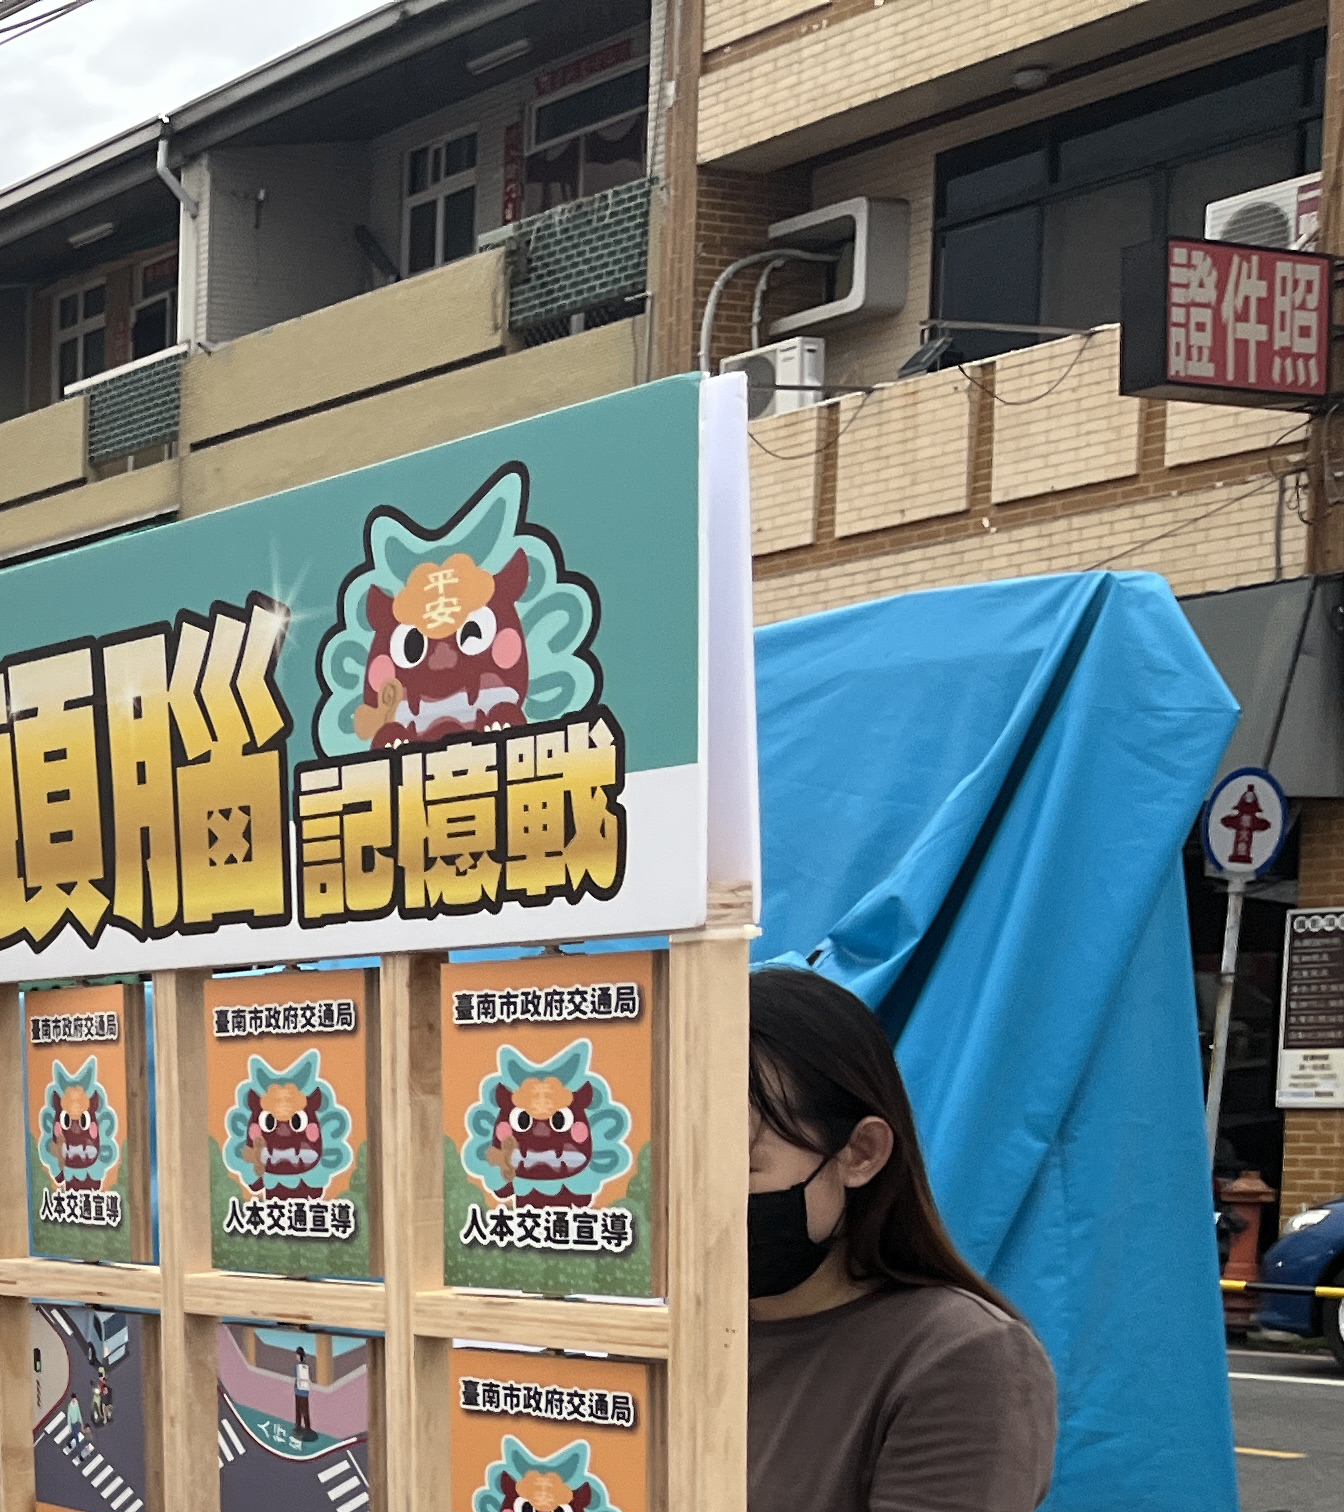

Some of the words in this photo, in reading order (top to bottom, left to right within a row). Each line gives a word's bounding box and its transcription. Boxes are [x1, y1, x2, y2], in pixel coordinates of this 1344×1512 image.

[1169, 248, 1320, 387] 證件照
[423, 568, 461, 629] 平安
[298, 716, 624, 926] 記憶戰
[214, 1001, 355, 1037] 臺南市政府交通局
[454, 987, 638, 1024] 臺南市政府交通局
[30, 1012, 119, 1043] 臺南市政府交通局
[40, 1188, 121, 1226] 人本交通宣導
[225, 1199, 355, 1240] 人本交通宣導
[462, 1210, 634, 1251] 人本交通宣導
[461, 1378, 634, 1426] 臺南市政府交通局
